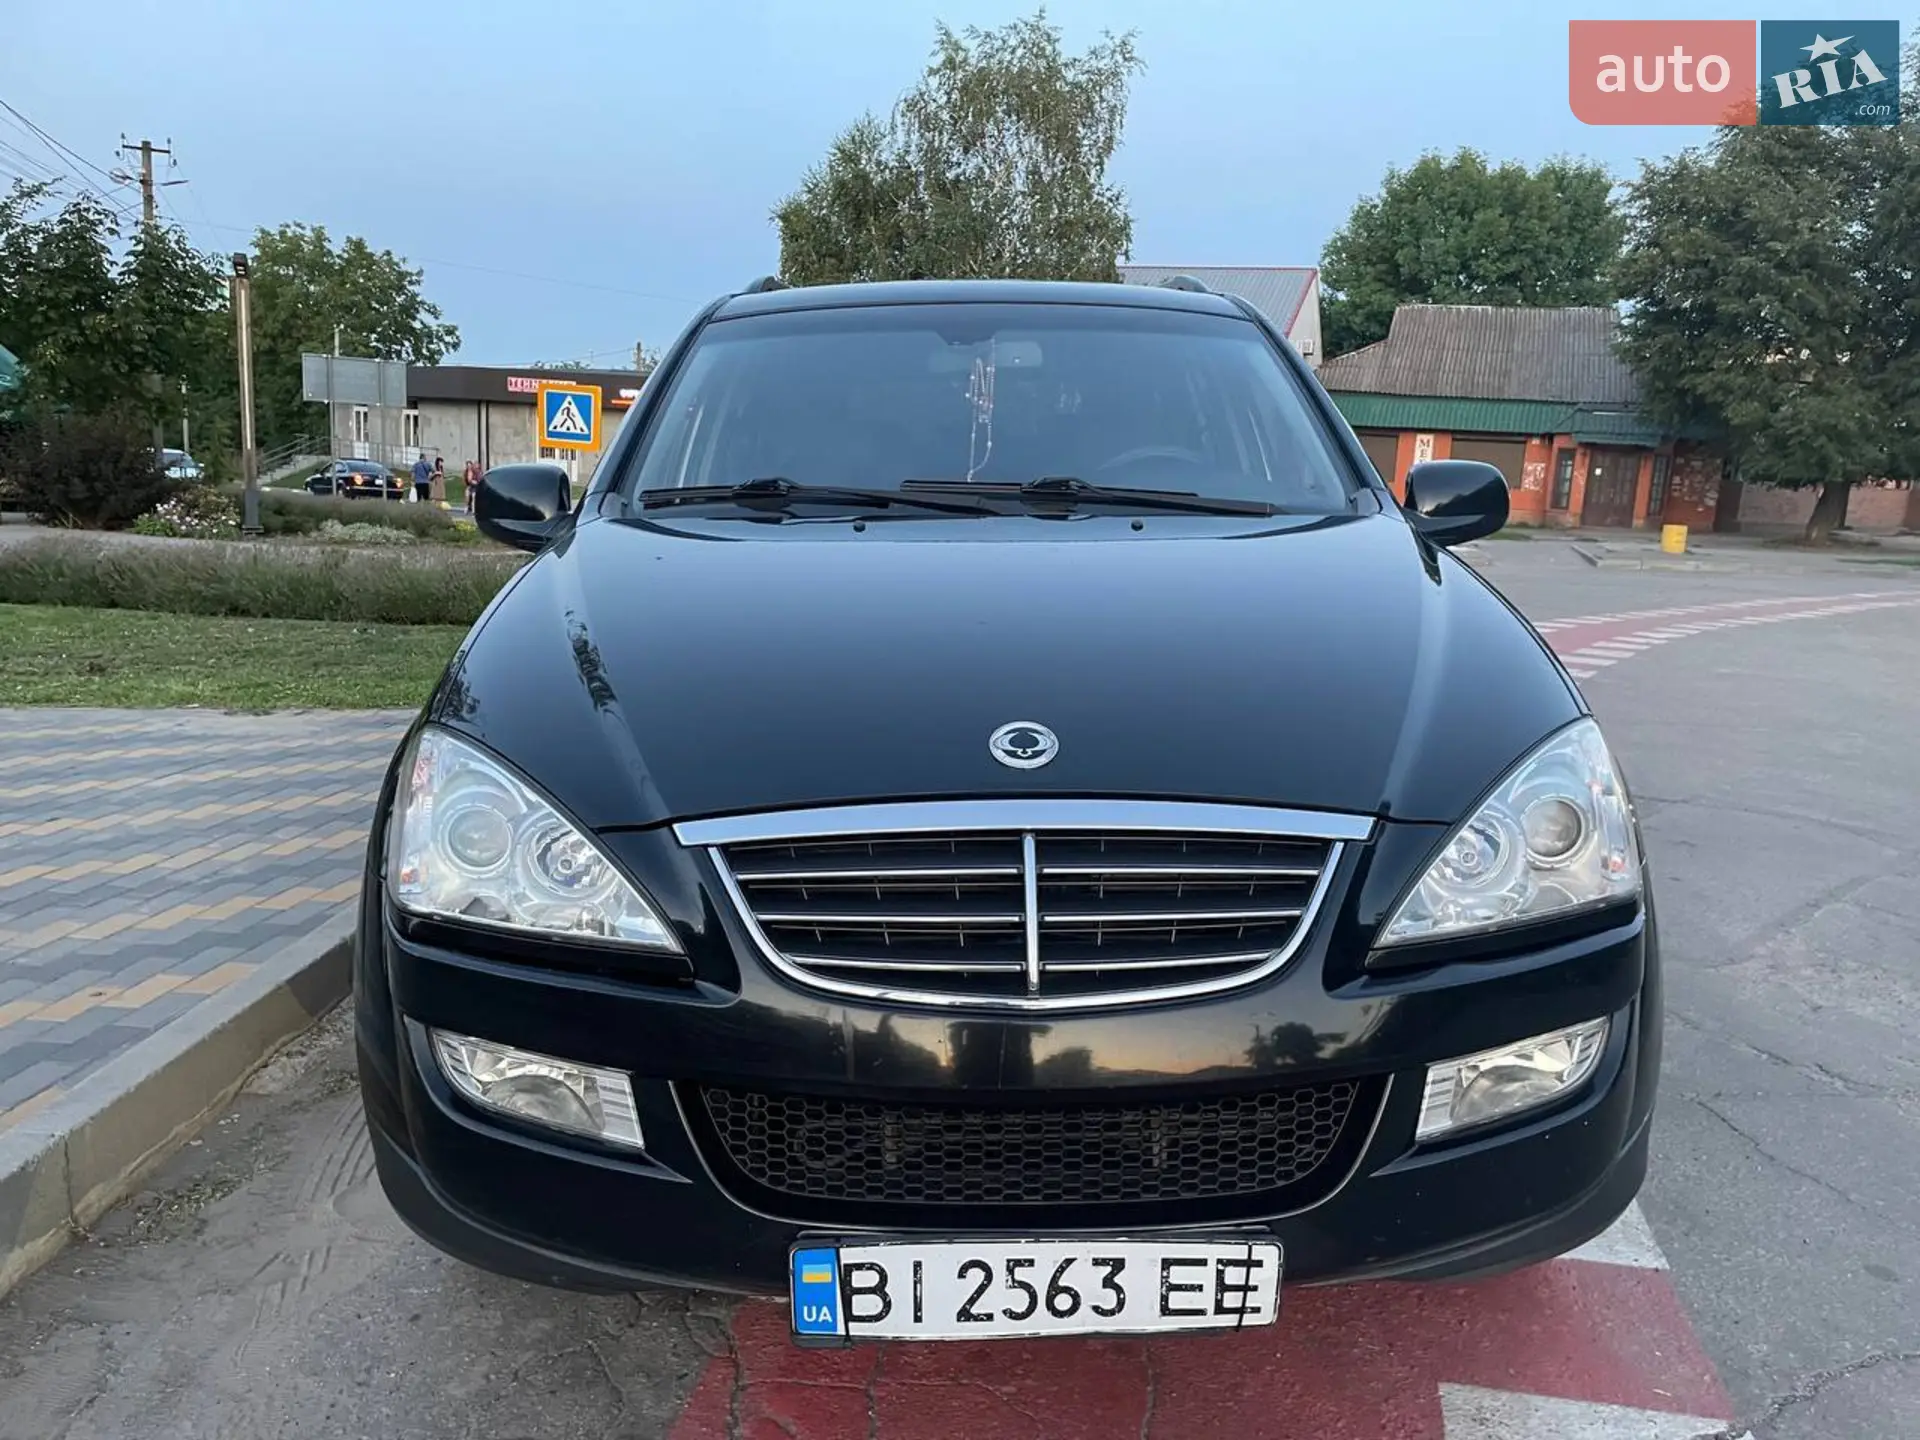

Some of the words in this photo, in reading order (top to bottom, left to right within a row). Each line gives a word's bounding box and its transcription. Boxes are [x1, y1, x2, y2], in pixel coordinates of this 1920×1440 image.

[842, 1261, 924, 1324] BI
[956, 1257, 1127, 1323] 2563
[1159, 1256, 1265, 1317] EE
[803, 1305, 833, 1323] UA
